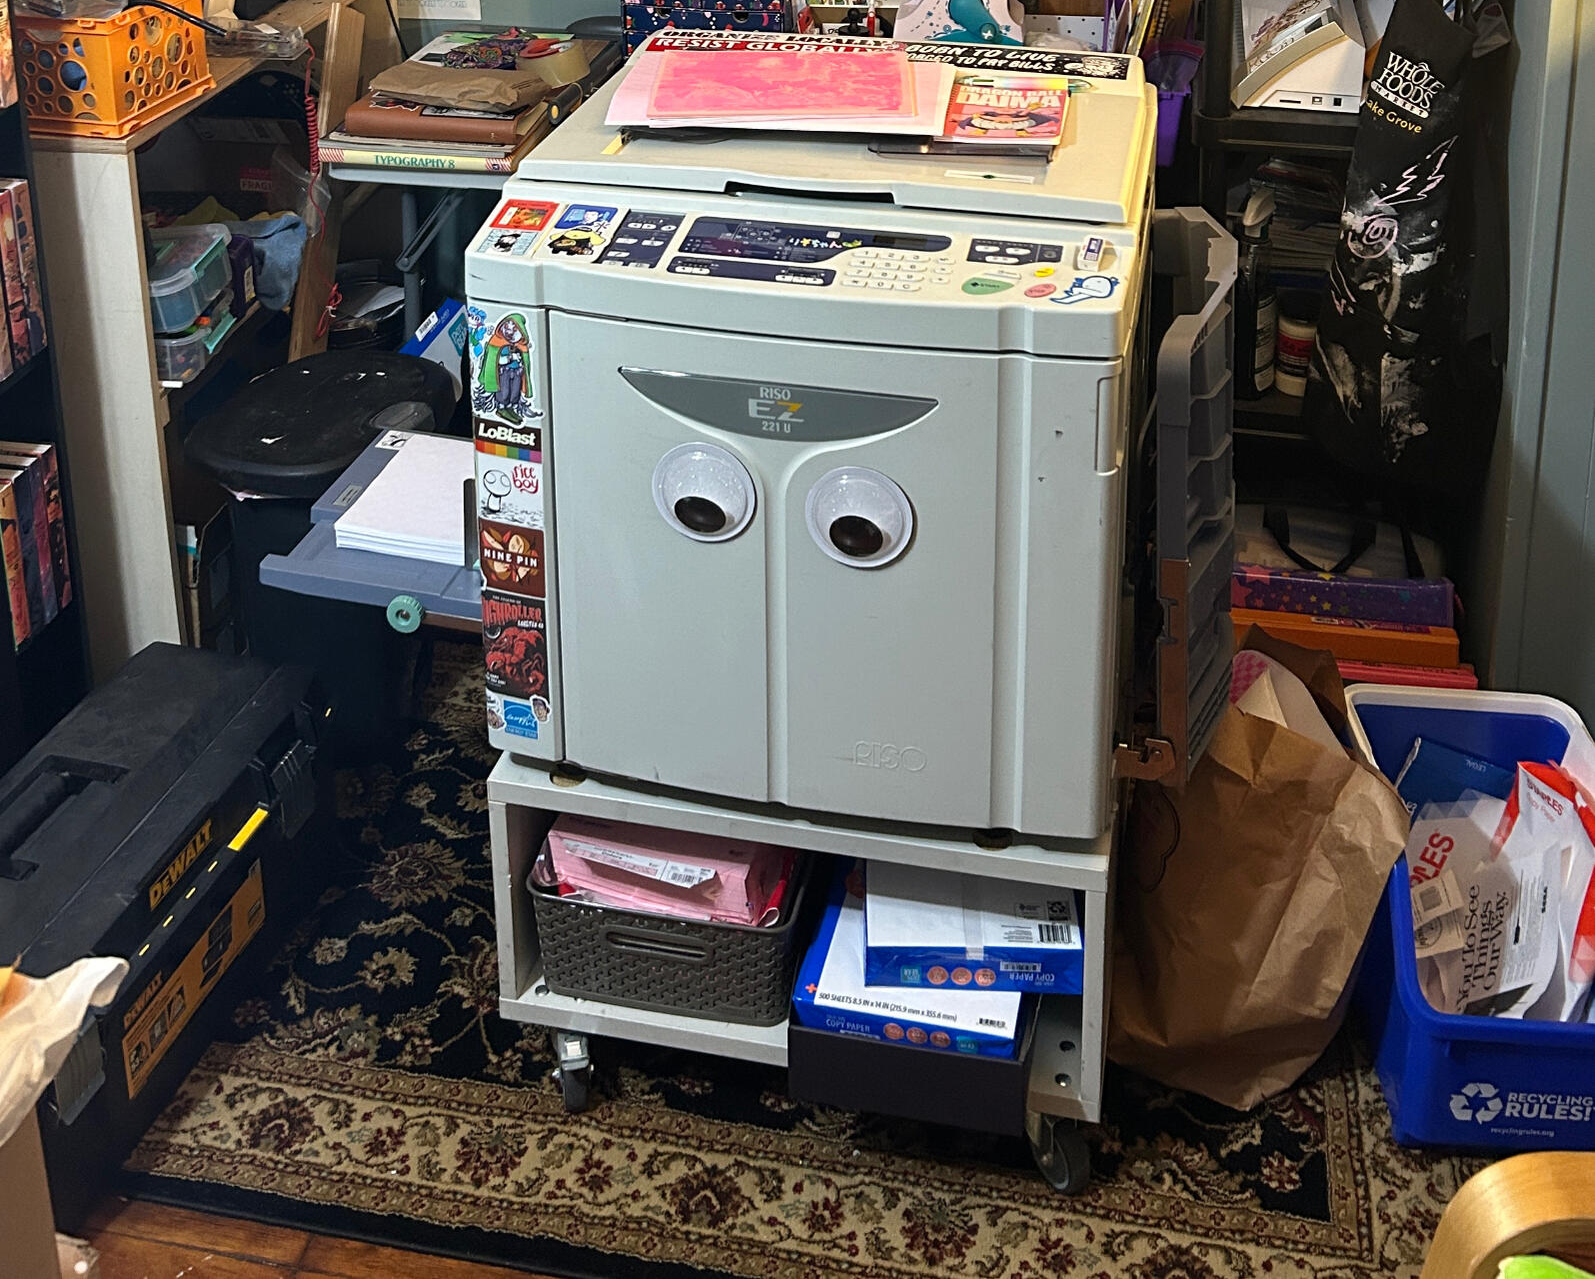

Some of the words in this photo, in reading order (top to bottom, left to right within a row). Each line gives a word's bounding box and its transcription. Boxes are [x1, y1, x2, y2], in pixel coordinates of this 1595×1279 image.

[655, 38, 743, 50] RESIST
[746, 42, 886, 53] GLOBALLY
[663, 30, 780, 42] ORGANIZE
[785, 35, 888, 48] LOCALLY
[905, 44, 968, 57] BORN
[973, 46, 1000, 58] TO
[1005, 50, 1060, 63] LIVE
[957, 55, 976, 65] TO
[981, 57, 1006, 68] PAY
[1009, 60, 1056, 71] BILLS
[1387, 51, 1445, 94] WHOLE
[960, 86, 1023, 97] DRAGON
[1025, 88, 1064, 97] BALL
[1376, 67, 1433, 109] FOODS
[956, 92, 1061, 108] DAIMA
[1374, 84, 1425, 116] MARKET
[1366, 99, 1385, 117] ake
[1386, 111, 1422, 133] Grove
[374, 155, 446, 169] TYPOGRAPHY
[448, 159, 455, 169] 8
[760, 386, 791, 401] RISO
[748, 398, 805, 422] EZ
[478, 422, 536, 446] LoBlast
[762, 421, 780, 432] 221
[784, 422, 791, 433] U
[513, 464, 537, 480] rice
[513, 476, 539, 494] boy
[484, 548, 512, 563] NINE
[517, 555, 538, 567] PIN
[856, 740, 928, 772] RISO
[1527, 776, 1565, 816] STAPLES
[150, 818, 212, 911] DEWALT
[1465, 884, 1480, 930] See
[1490, 891, 1509, 945] Way.
[1472, 900, 1493, 987] Things
[1484, 947, 1500, 991] Our
[819, 992, 830, 1000] 500
[831, 994, 852, 1004] SHEETS
[852, 997, 862, 1005] 8.5
[862, 998, 870, 1006] IN
[875, 1000, 882, 1008] 14
[882, 1001, 889, 1009] IN
[890, 1002, 907, 1013] (215.9
[907, 1007, 920, 1015] mm
[925, 1008, 941, 1019] 355.6
[942, 1012, 957, 1023] mm)
[826, 1018, 845, 1028] COPY
[846, 1021, 871, 1032] PAPER
[1508, 1092, 1594, 1107] RECYCLING
[1505, 1102, 1592, 1122] RULES!
[1490, 1127, 1555, 1138] recyclingrules.org
